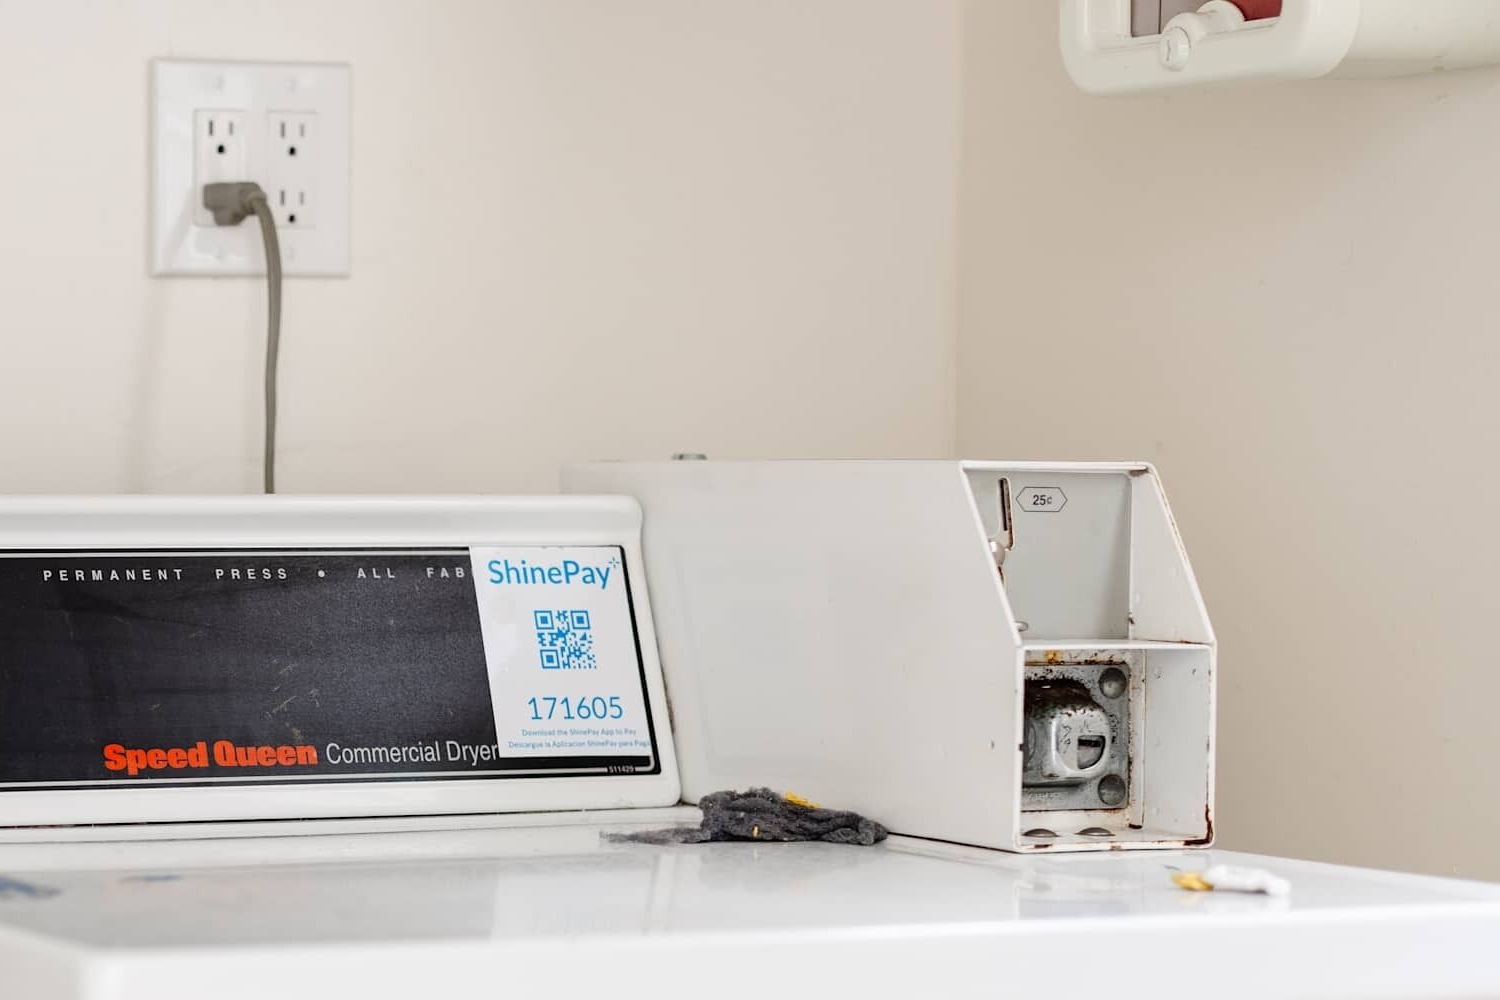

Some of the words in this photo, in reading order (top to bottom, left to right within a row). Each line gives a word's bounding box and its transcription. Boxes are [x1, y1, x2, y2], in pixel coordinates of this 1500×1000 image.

[43, 569, 183, 582] PERMANENT
[215, 568, 288, 581] PRESS
[356, 567, 396, 579] ALL
[426, 567, 466, 579] FAB
[487, 559, 611, 590] ShinePay
[527, 696, 624, 720] 171605
[103, 742, 209, 776] Speed
[213, 740, 318, 767] Queen
[326, 740, 442, 765] Commercial
[447, 740, 498, 766] Dryer
